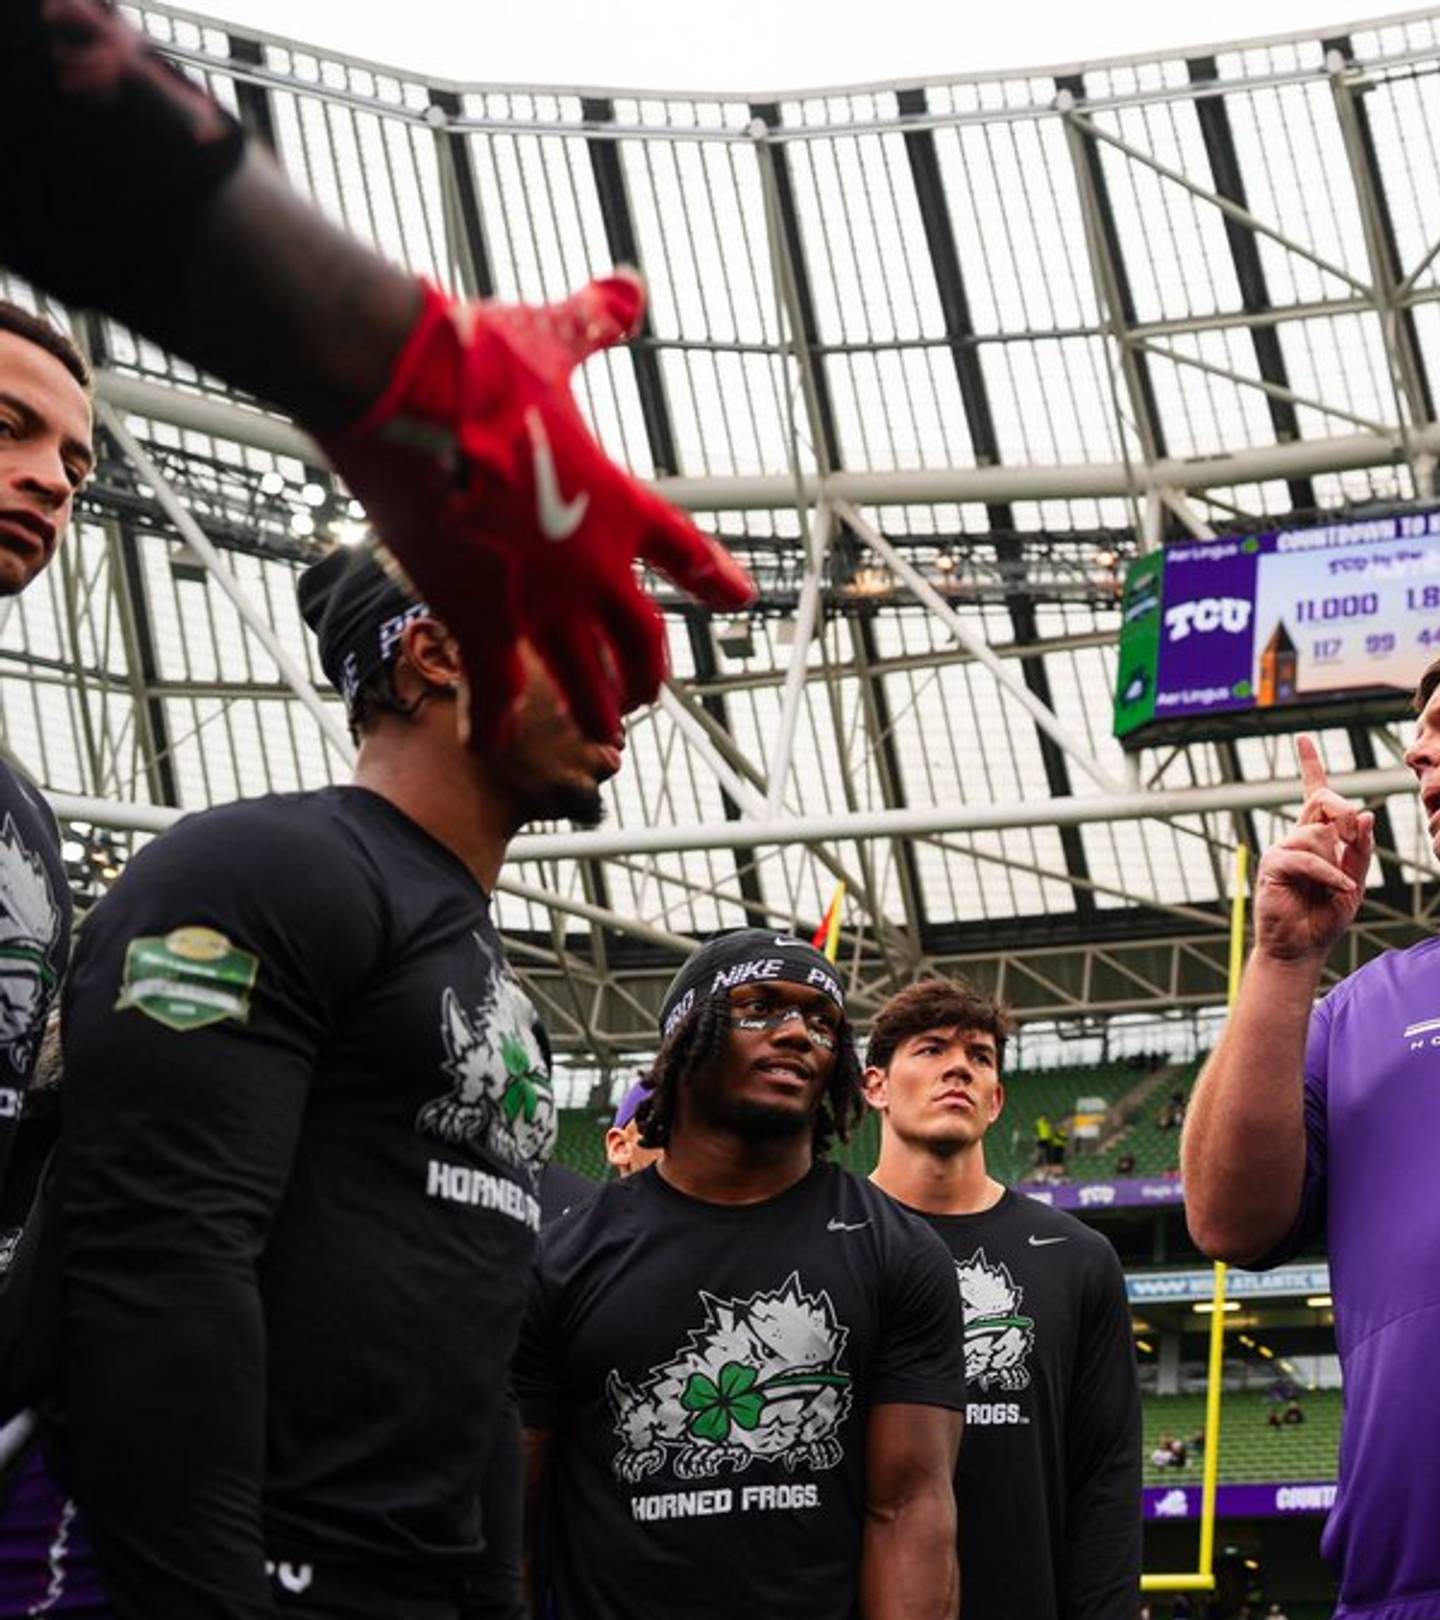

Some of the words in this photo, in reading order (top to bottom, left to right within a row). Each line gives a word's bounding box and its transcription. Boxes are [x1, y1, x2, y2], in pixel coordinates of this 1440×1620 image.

[1401, 514, 1425, 537] TO
[1165, 597, 1251, 641] TCU
[710, 958, 784, 994] NIKE
[965, 1403, 1020, 1425] ROGS
[631, 1488, 733, 1521] HORNED
